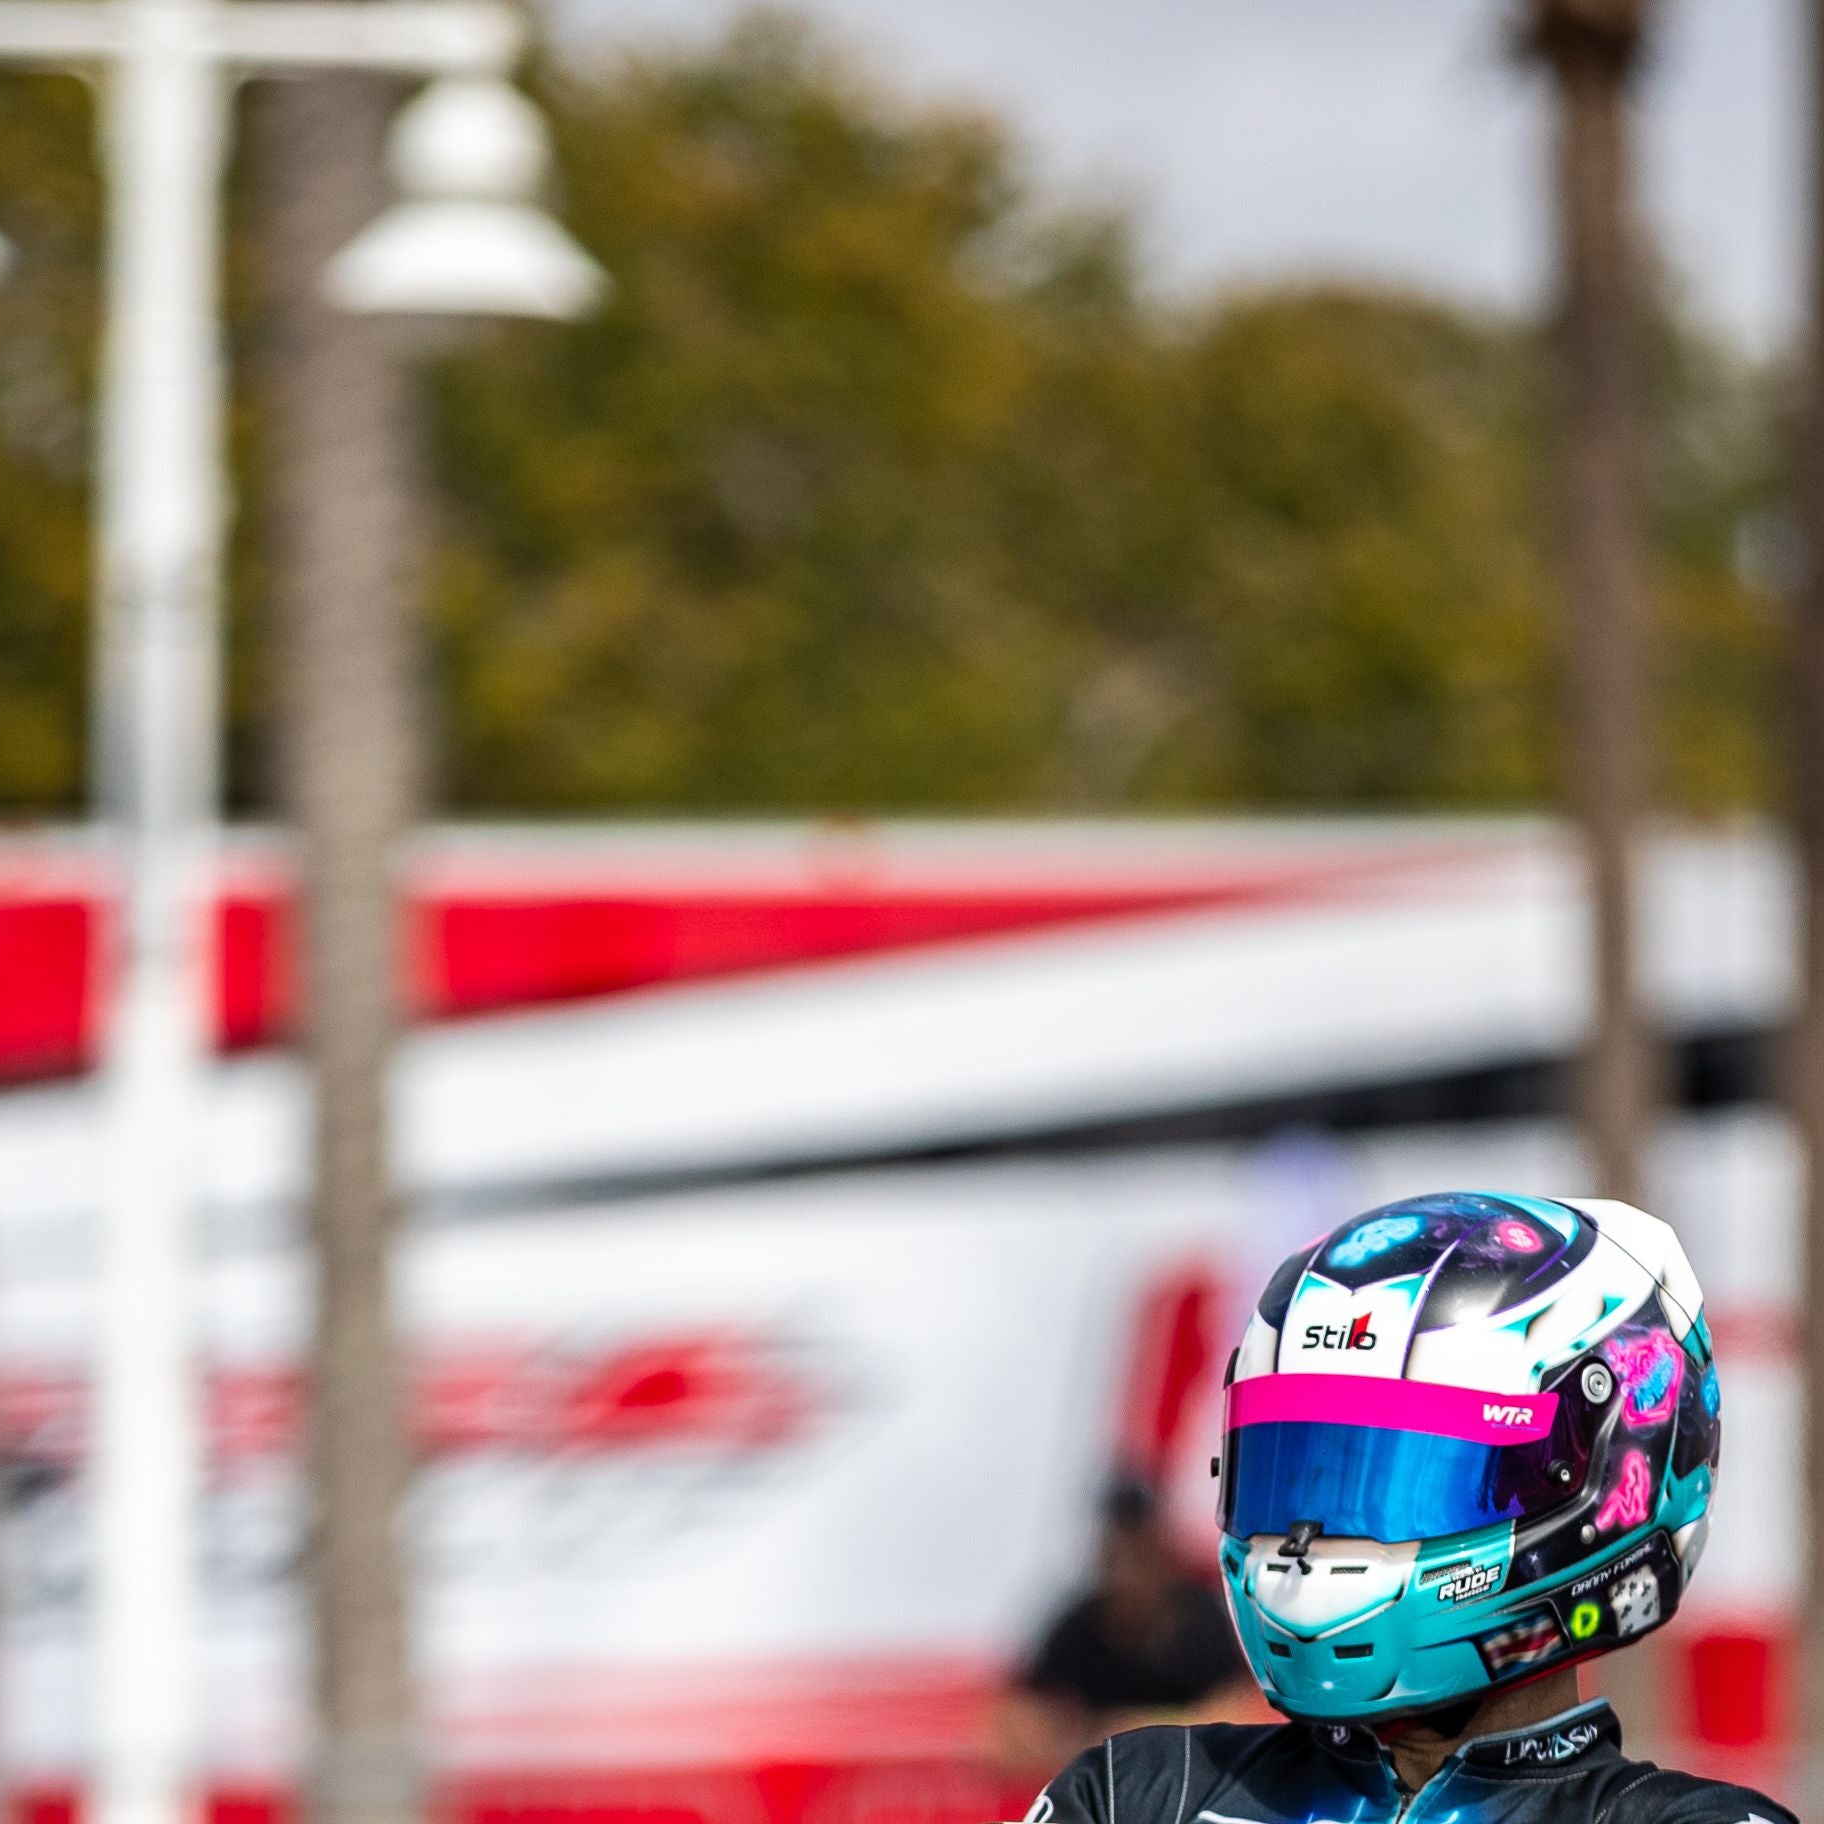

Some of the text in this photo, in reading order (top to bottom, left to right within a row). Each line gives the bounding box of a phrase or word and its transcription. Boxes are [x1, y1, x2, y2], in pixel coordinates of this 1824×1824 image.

[1302, 1313, 1376, 1350] Stilo
[1483, 1404, 1533, 1425] WTR
[1439, 1566, 1500, 1600] RUDE
